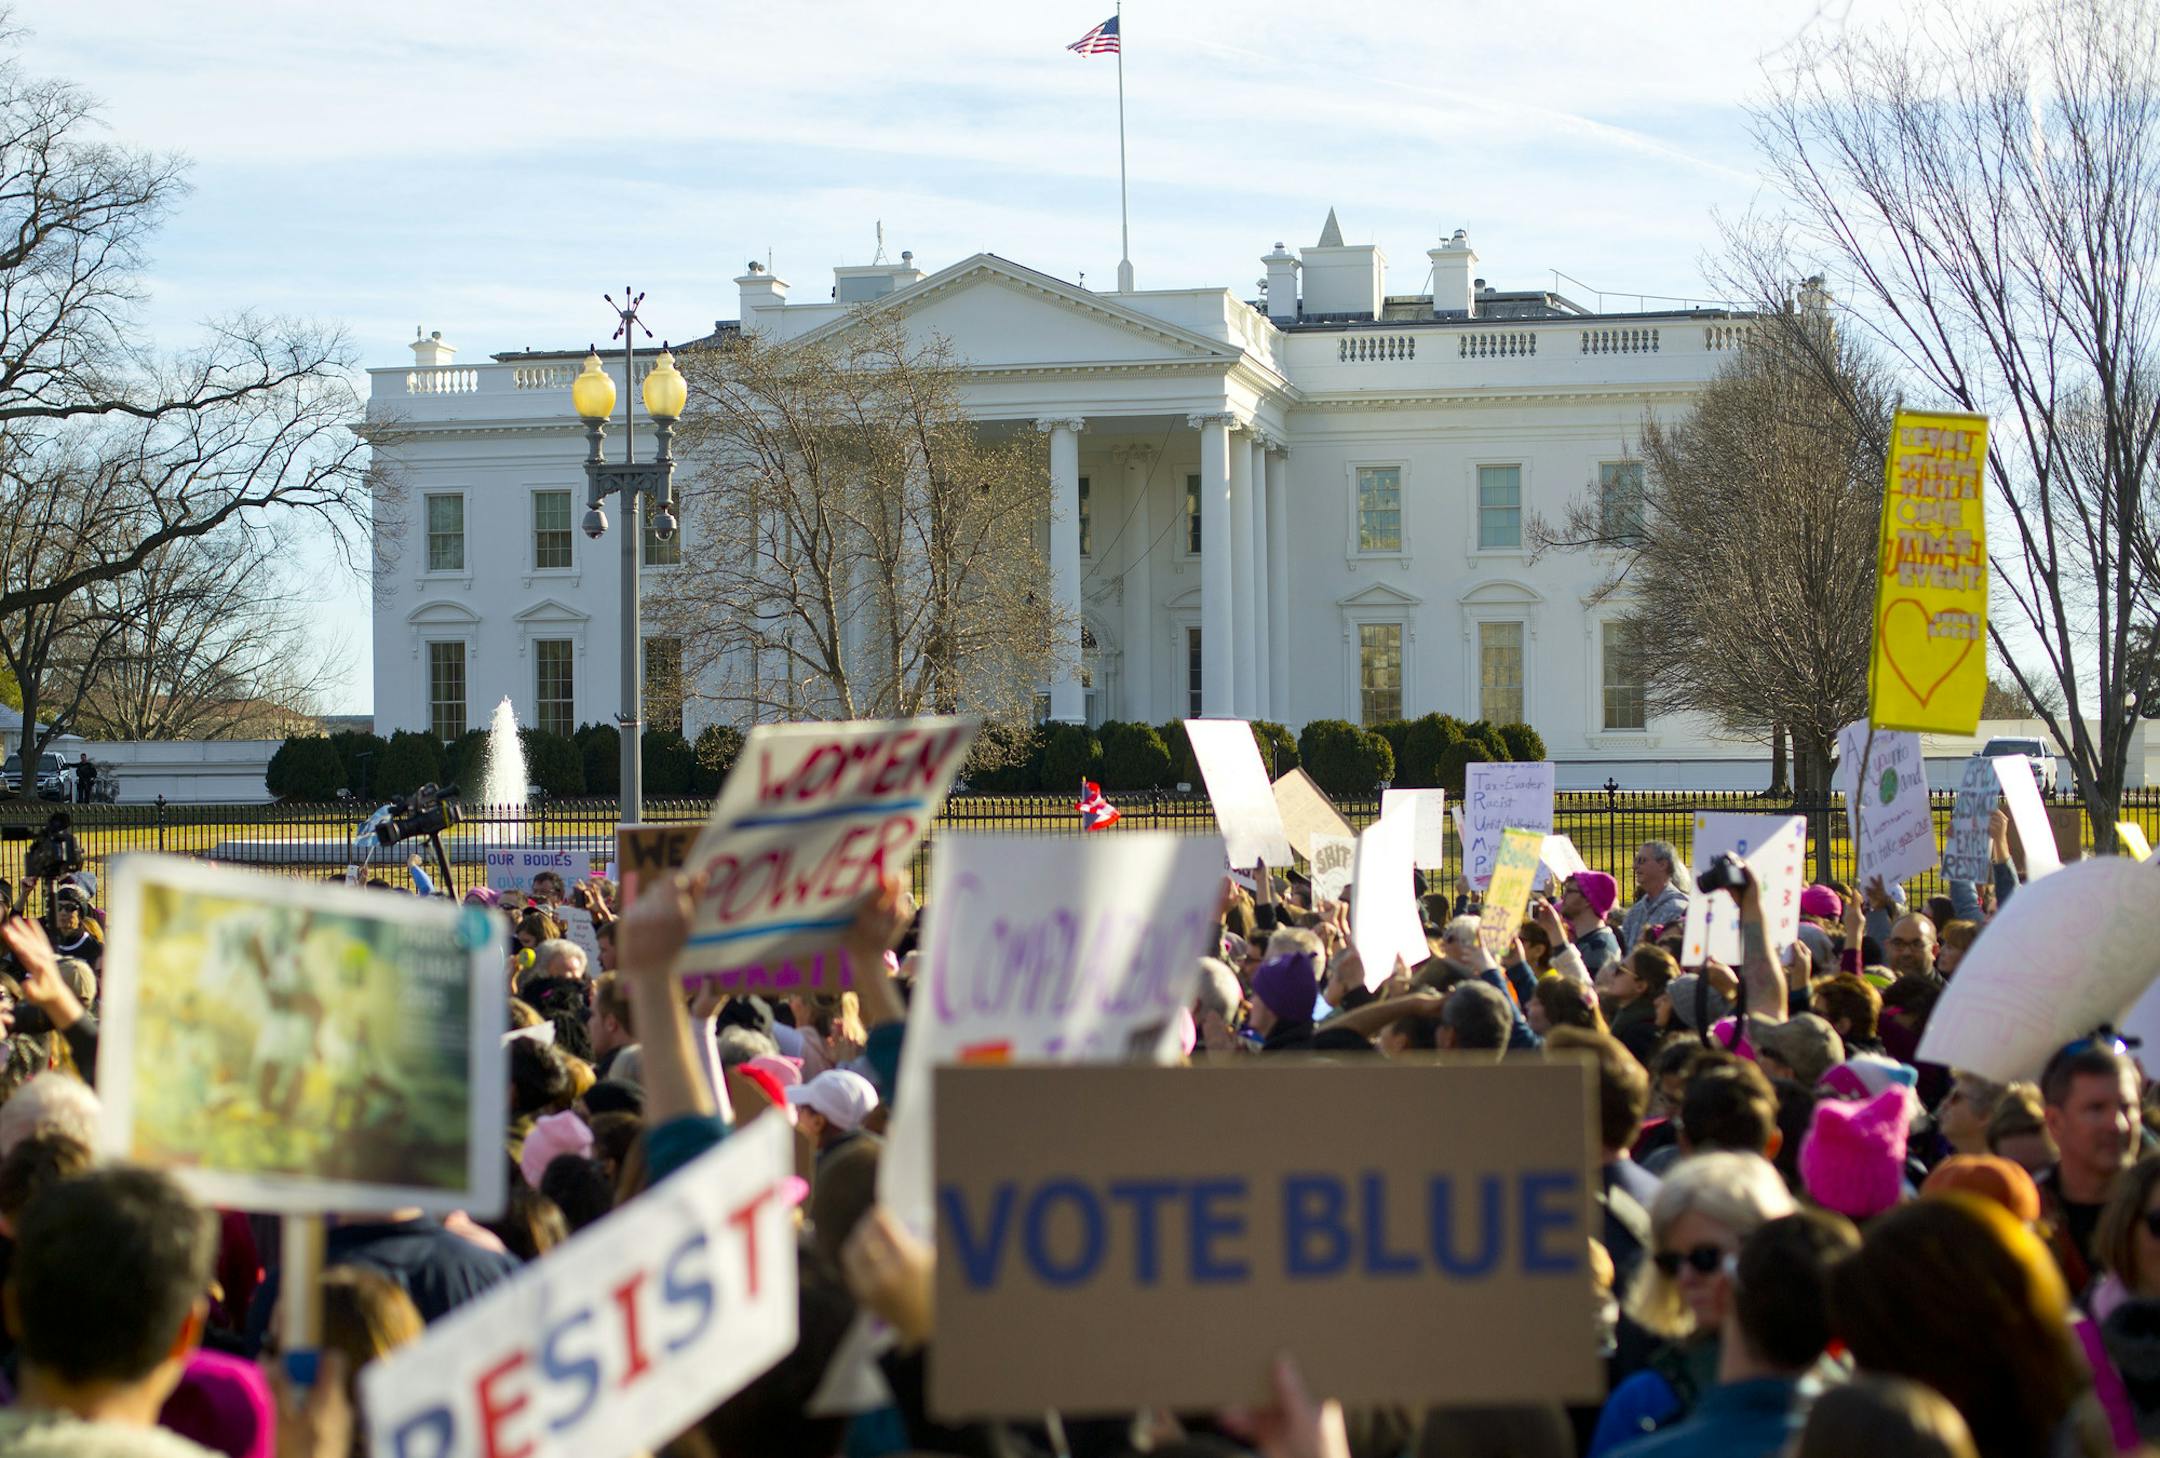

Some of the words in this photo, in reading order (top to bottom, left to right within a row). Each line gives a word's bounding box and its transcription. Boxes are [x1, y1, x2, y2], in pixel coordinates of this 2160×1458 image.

[1896, 498, 1963, 528] ONE
[1898, 561, 1985, 593] EVENT
[757, 725, 961, 804] WOMEN
[1473, 791, 1518, 811] Racist
[487, 852, 514, 866] OUR
[523, 852, 573, 867] BODIES
[630, 834, 690, 868] WE
[1315, 843, 1352, 875] SHIT
[497, 876, 525, 890] OUR
[704, 813, 917, 924] POWER
[941, 1173, 1251, 1291] VOTE
[1282, 1171, 1581, 1282] BLUE
